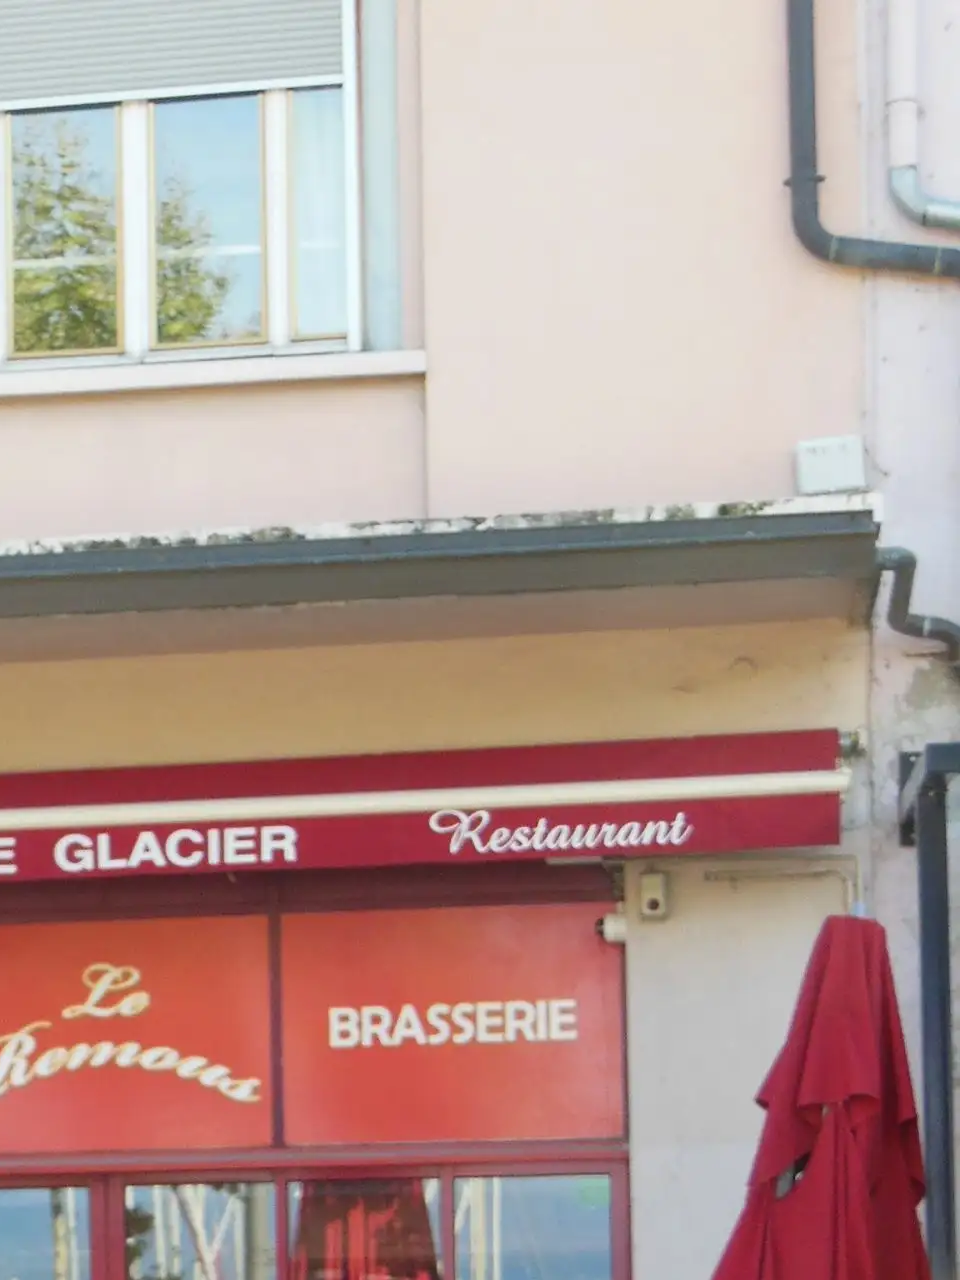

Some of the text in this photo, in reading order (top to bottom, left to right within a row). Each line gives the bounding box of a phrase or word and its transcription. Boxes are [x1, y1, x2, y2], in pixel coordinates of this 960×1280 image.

[54, 825, 299, 873] GLACIER
[428, 808, 694, 855] Restaurant
[61, 962, 151, 1019] Le
[327, 999, 579, 1049] BRASSERIE
